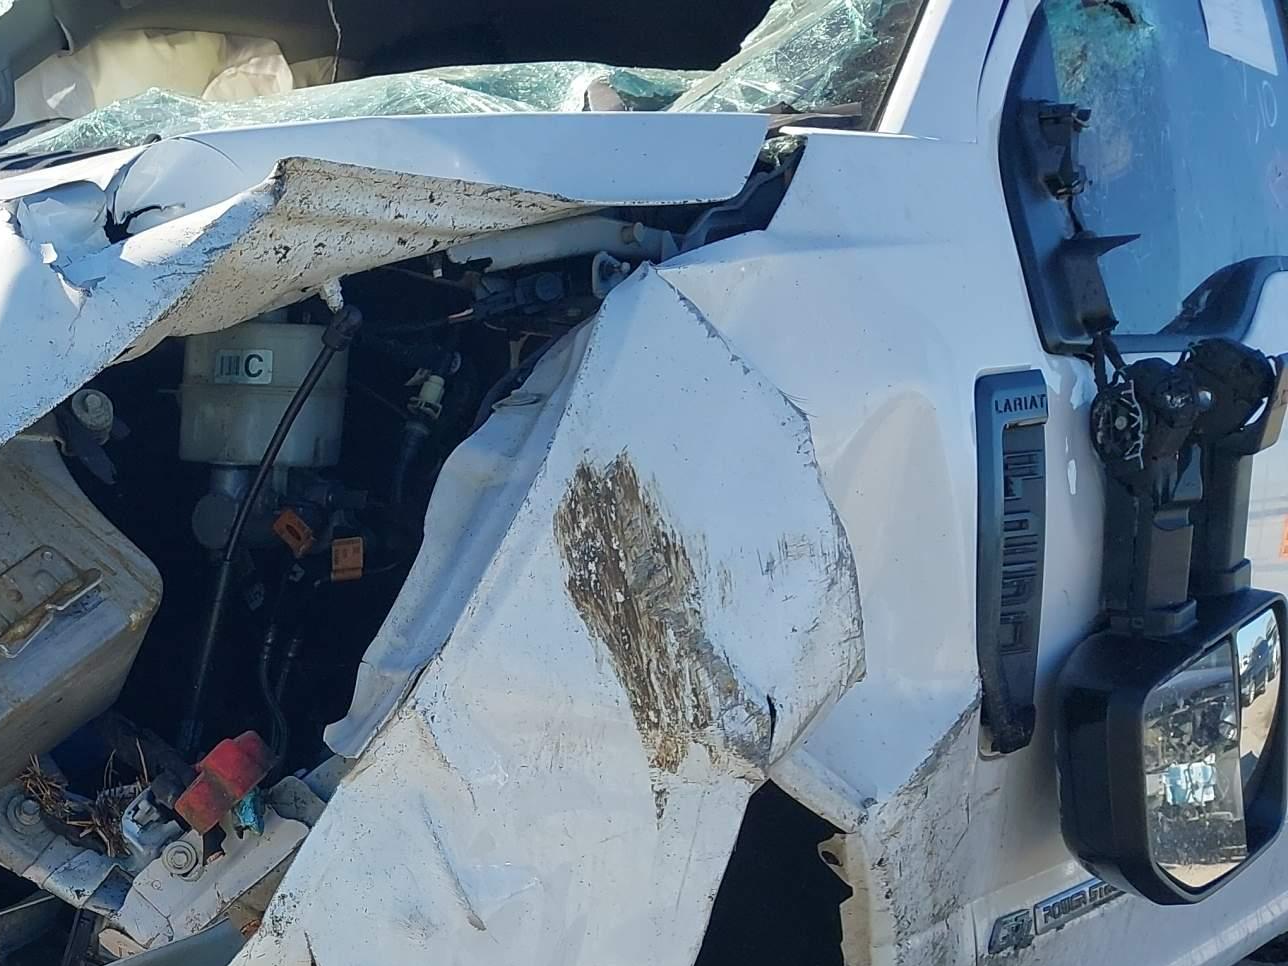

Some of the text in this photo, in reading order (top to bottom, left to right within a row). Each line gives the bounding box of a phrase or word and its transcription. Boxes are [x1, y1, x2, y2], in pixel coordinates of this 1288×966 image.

[244, 353, 264, 378] C
[994, 393, 1047, 414] LARIAT
[1042, 889, 1088, 925] POWER
